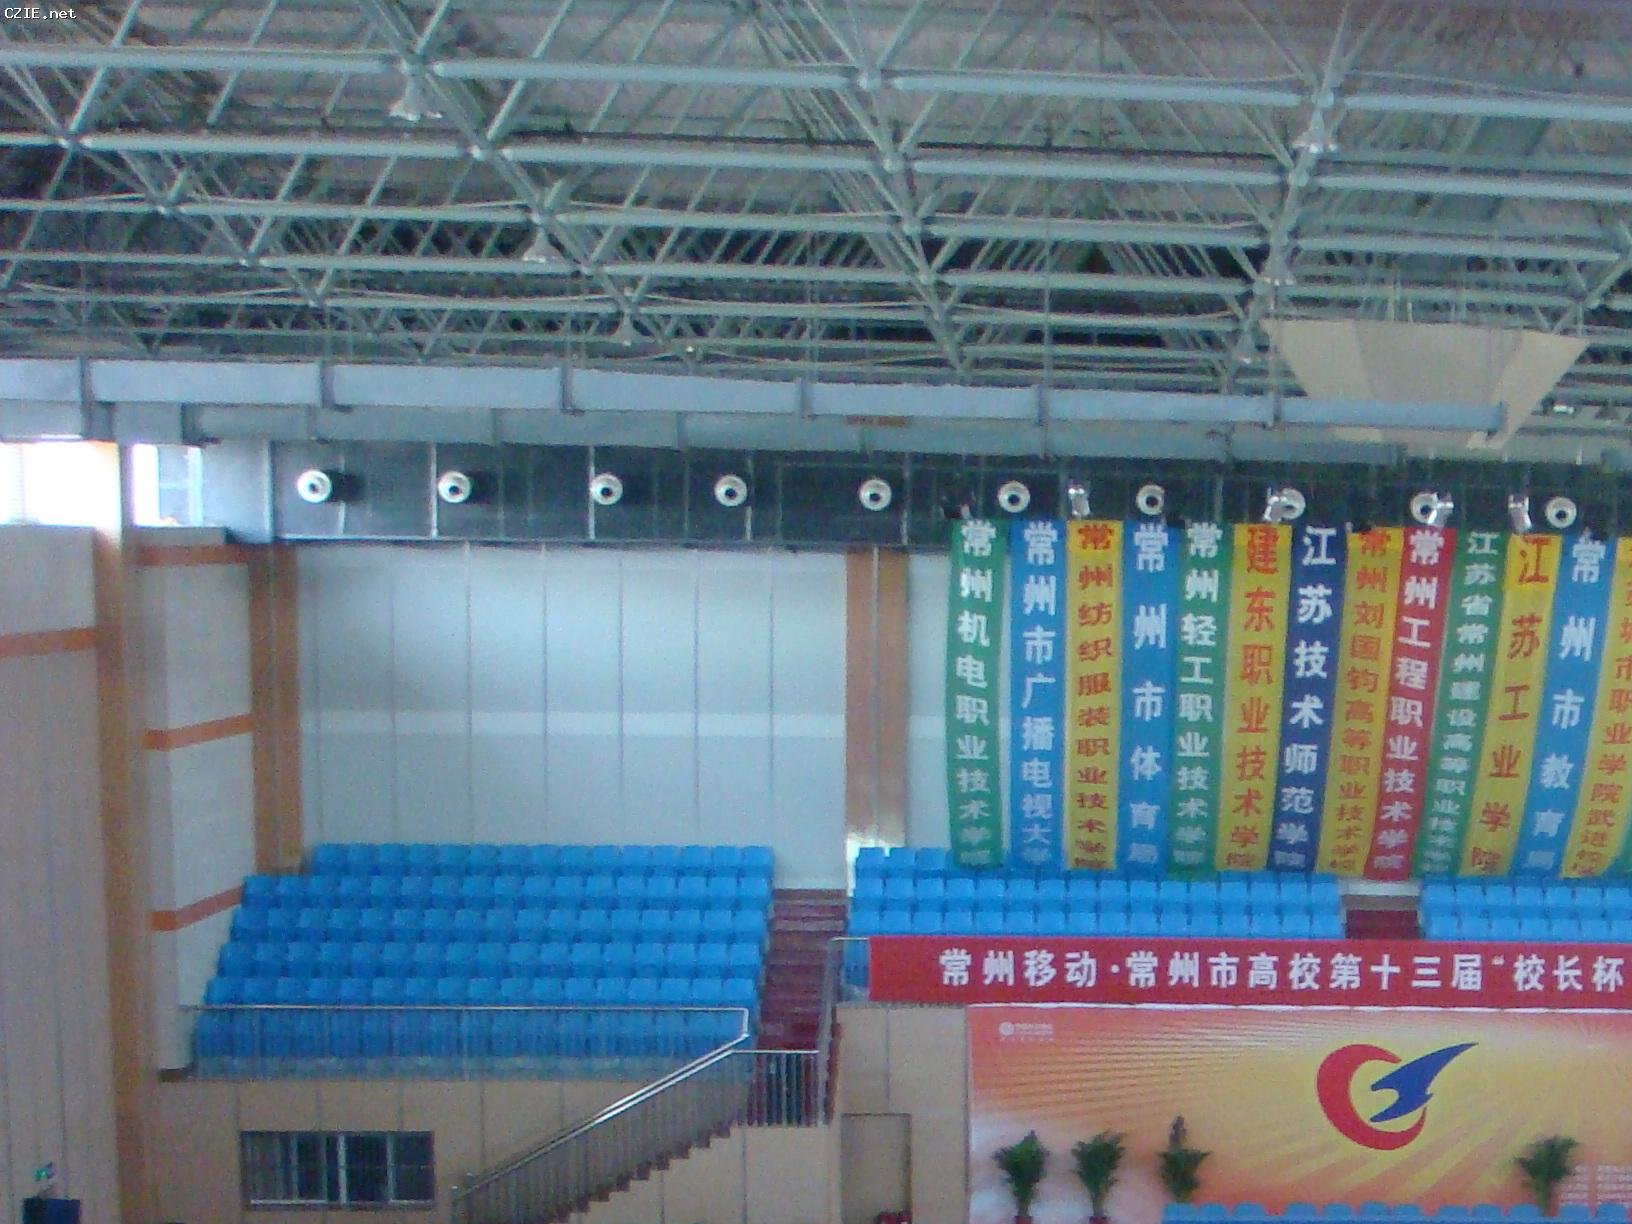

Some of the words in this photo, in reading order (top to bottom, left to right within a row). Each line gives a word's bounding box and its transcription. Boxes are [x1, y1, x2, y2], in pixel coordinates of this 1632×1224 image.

[1075, 523, 1114, 867] 常州纺织服装职业技术学
